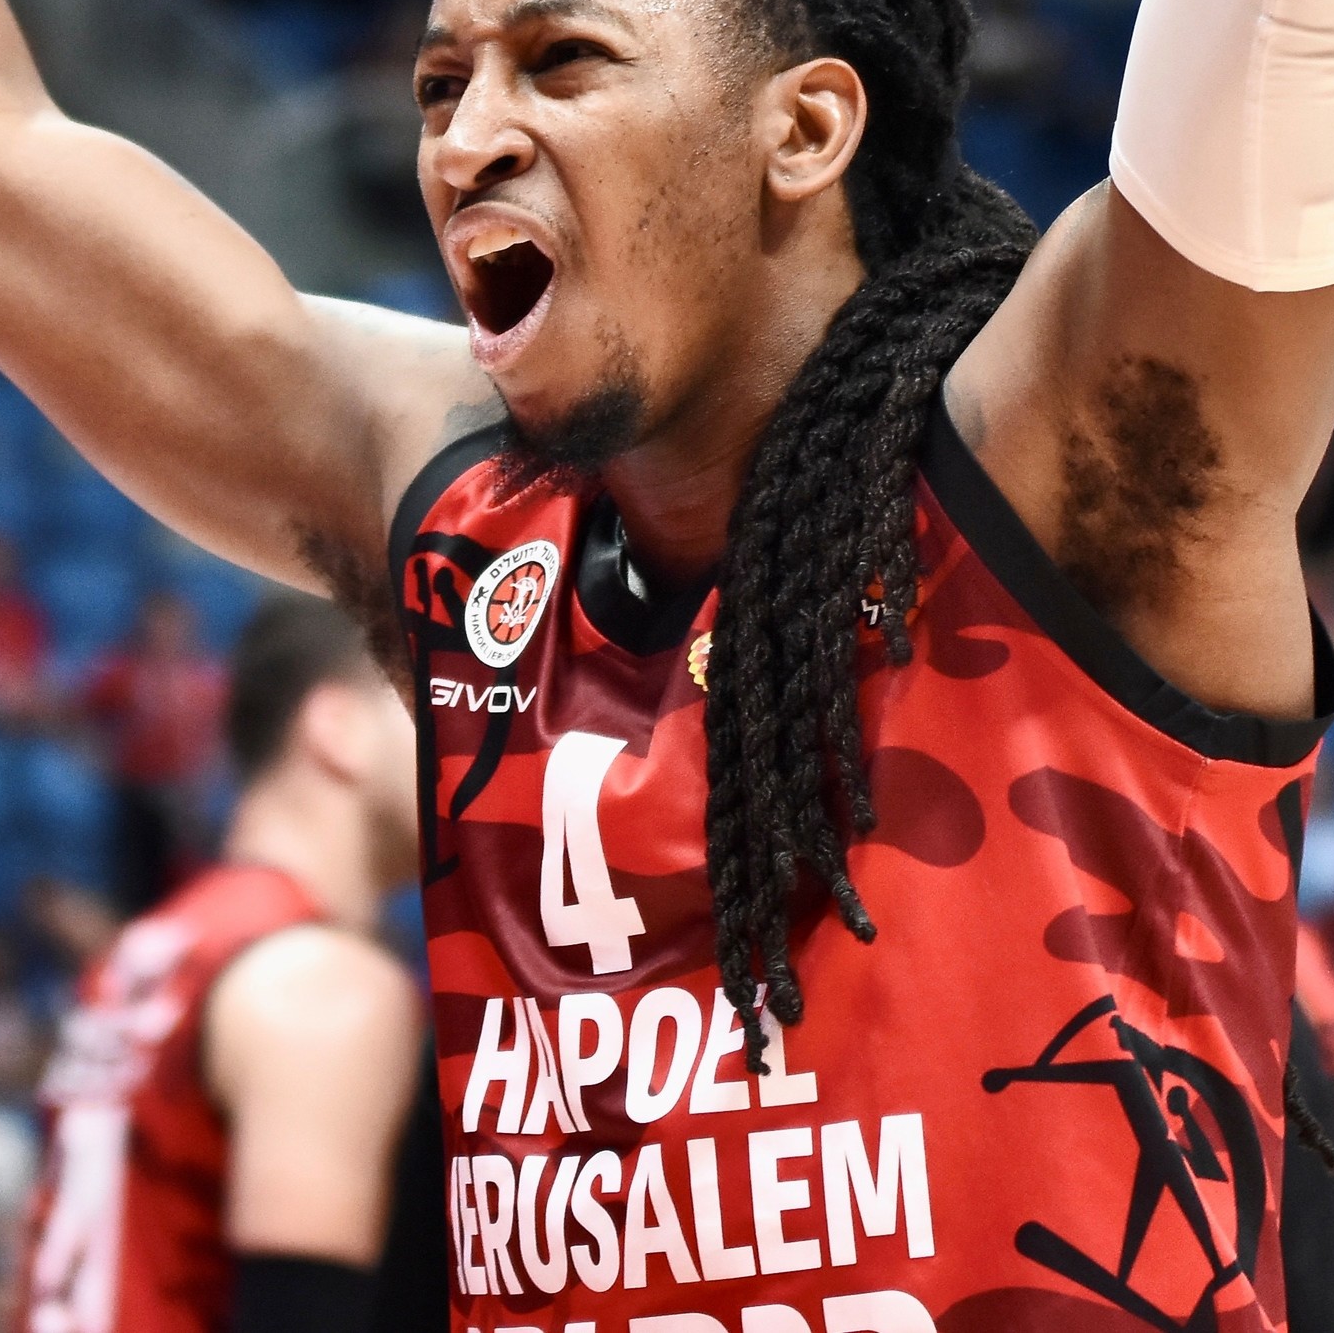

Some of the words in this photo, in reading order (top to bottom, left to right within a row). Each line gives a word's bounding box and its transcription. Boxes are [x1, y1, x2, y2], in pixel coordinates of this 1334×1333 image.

[489, 545, 539, 579] ירושלים
[471, 613, 491, 656] HAPOEL
[539, 730, 647, 977] 4
[462, 983, 819, 1136] HAPOEL
